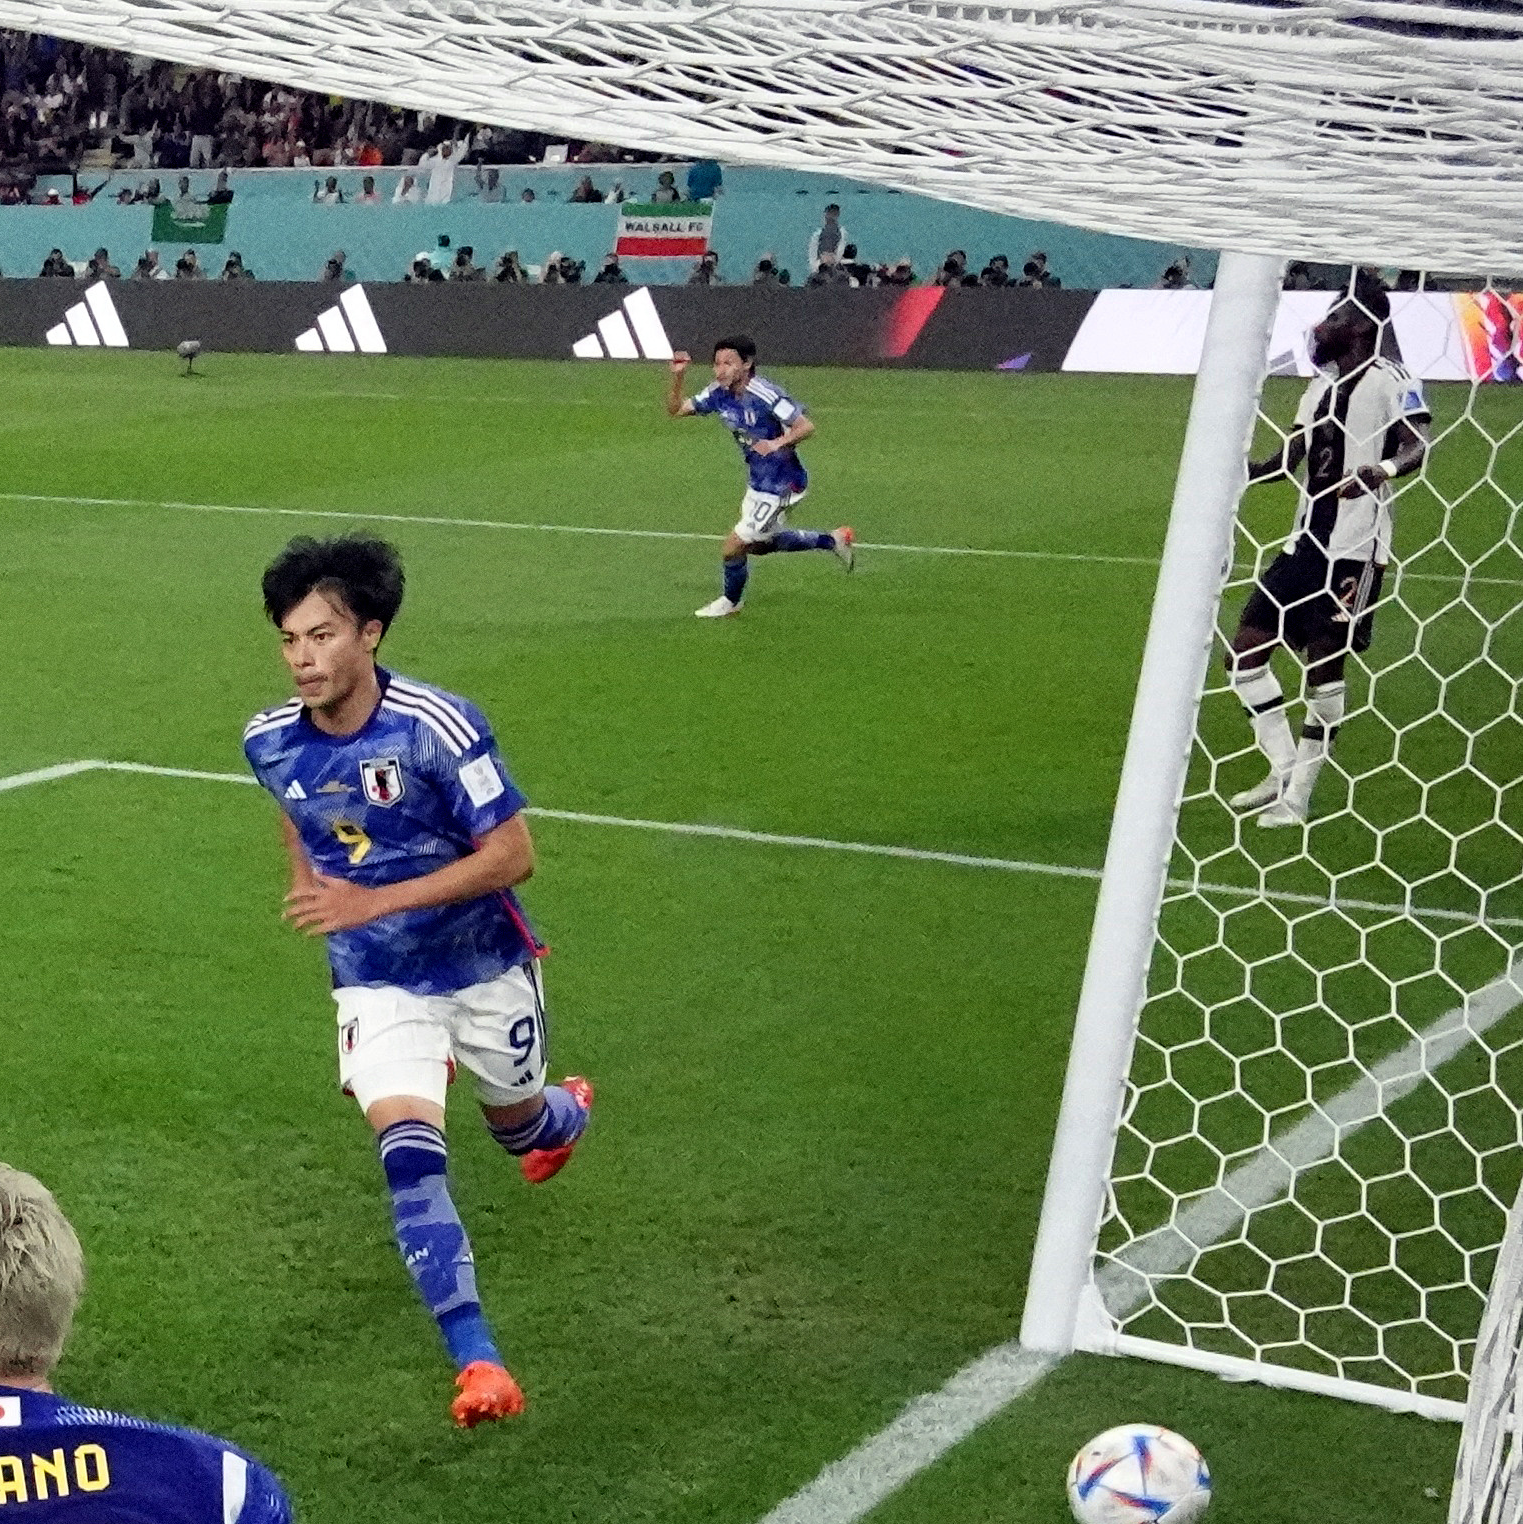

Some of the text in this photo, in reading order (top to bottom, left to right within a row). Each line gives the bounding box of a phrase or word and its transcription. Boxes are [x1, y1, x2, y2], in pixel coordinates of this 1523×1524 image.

[624, 221, 683, 233] WALSALL
[1316, 446, 1333, 480] 2
[1339, 575, 1359, 607] 2
[333, 819, 372, 865] 9
[508, 1015, 536, 1068] 9
